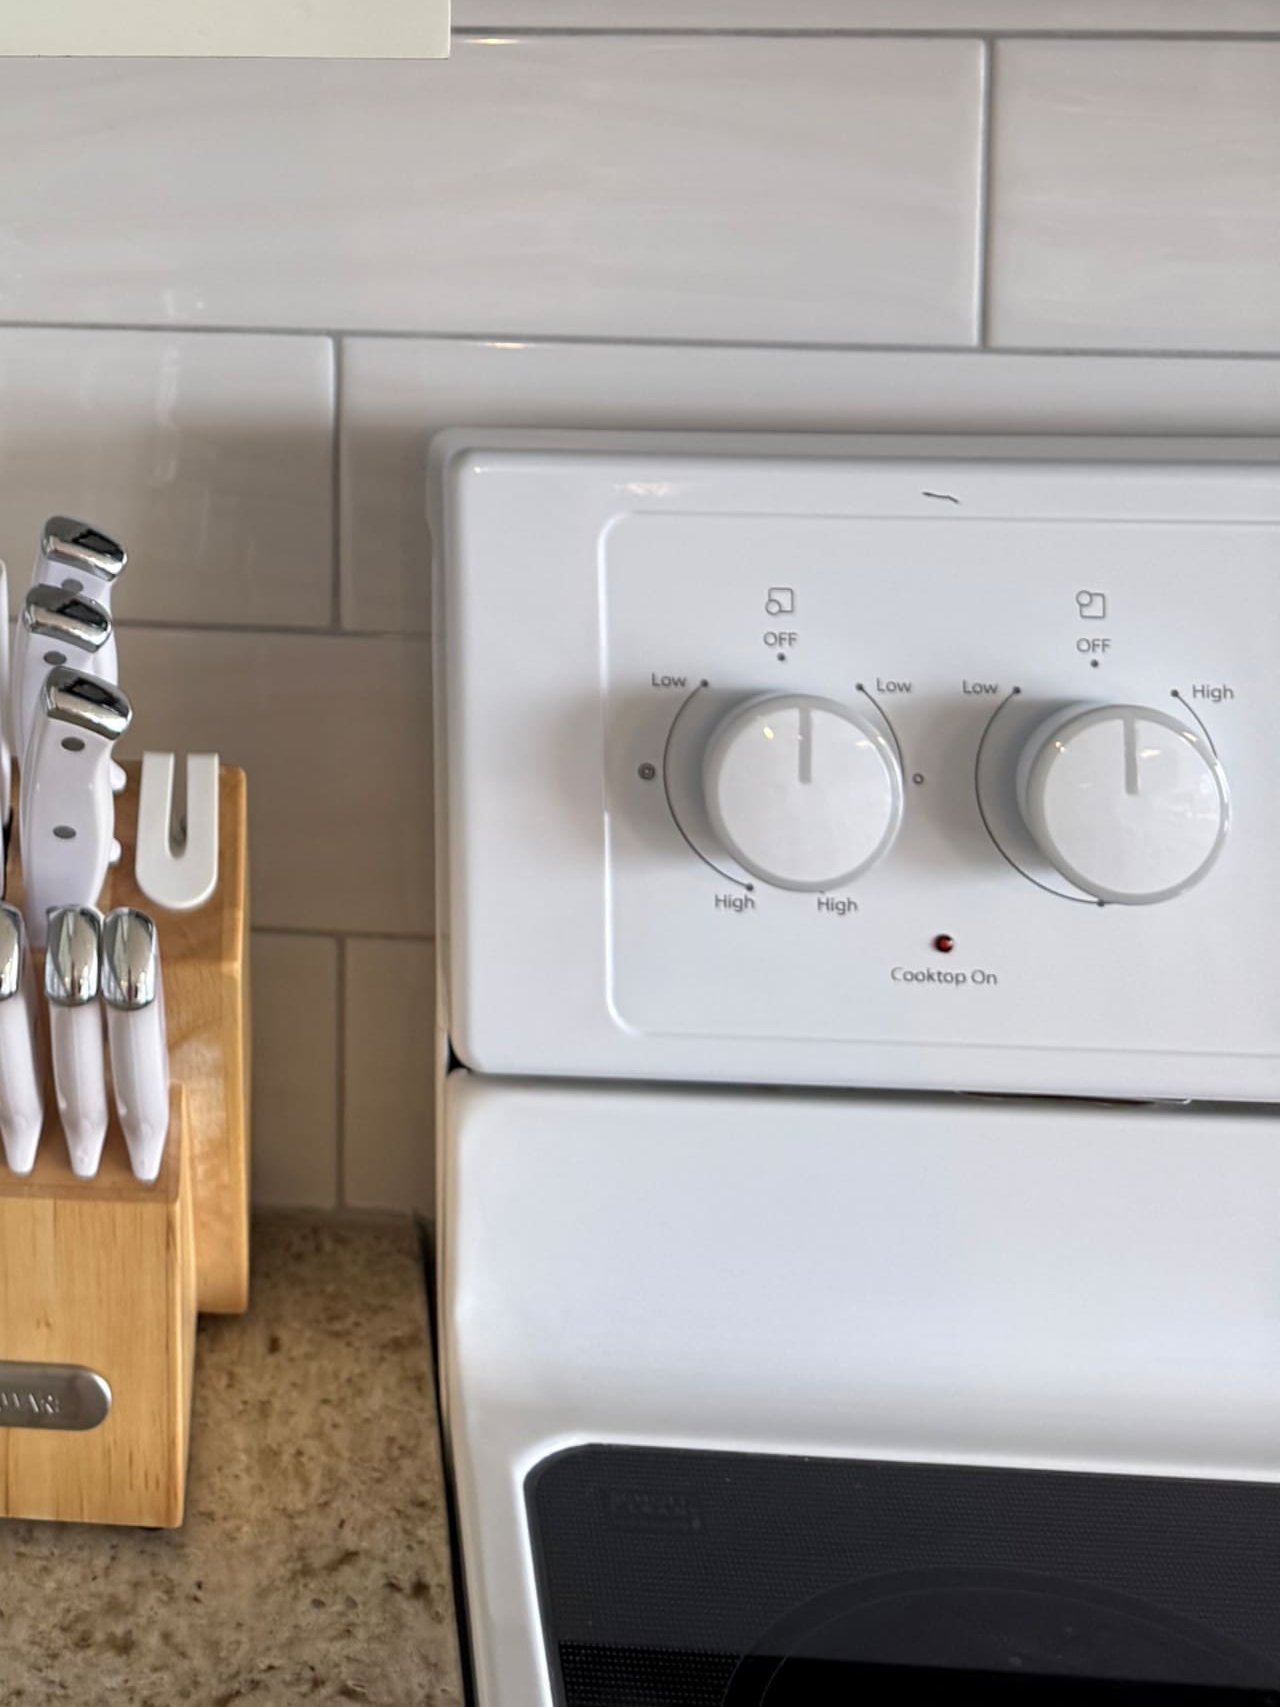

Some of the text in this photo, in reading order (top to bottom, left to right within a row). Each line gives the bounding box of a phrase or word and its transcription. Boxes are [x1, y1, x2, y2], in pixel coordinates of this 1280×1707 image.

[763, 632, 798, 647] OFF
[1076, 638, 1111, 654] OFF
[652, 672, 687, 688] Low
[876, 677, 912, 693] Low
[963, 679, 998, 695] Low
[1192, 684, 1234, 703] High
[715, 894, 756, 912] High
[817, 896, 858, 915] High
[891, 967, 998, 987] Cooktop On
